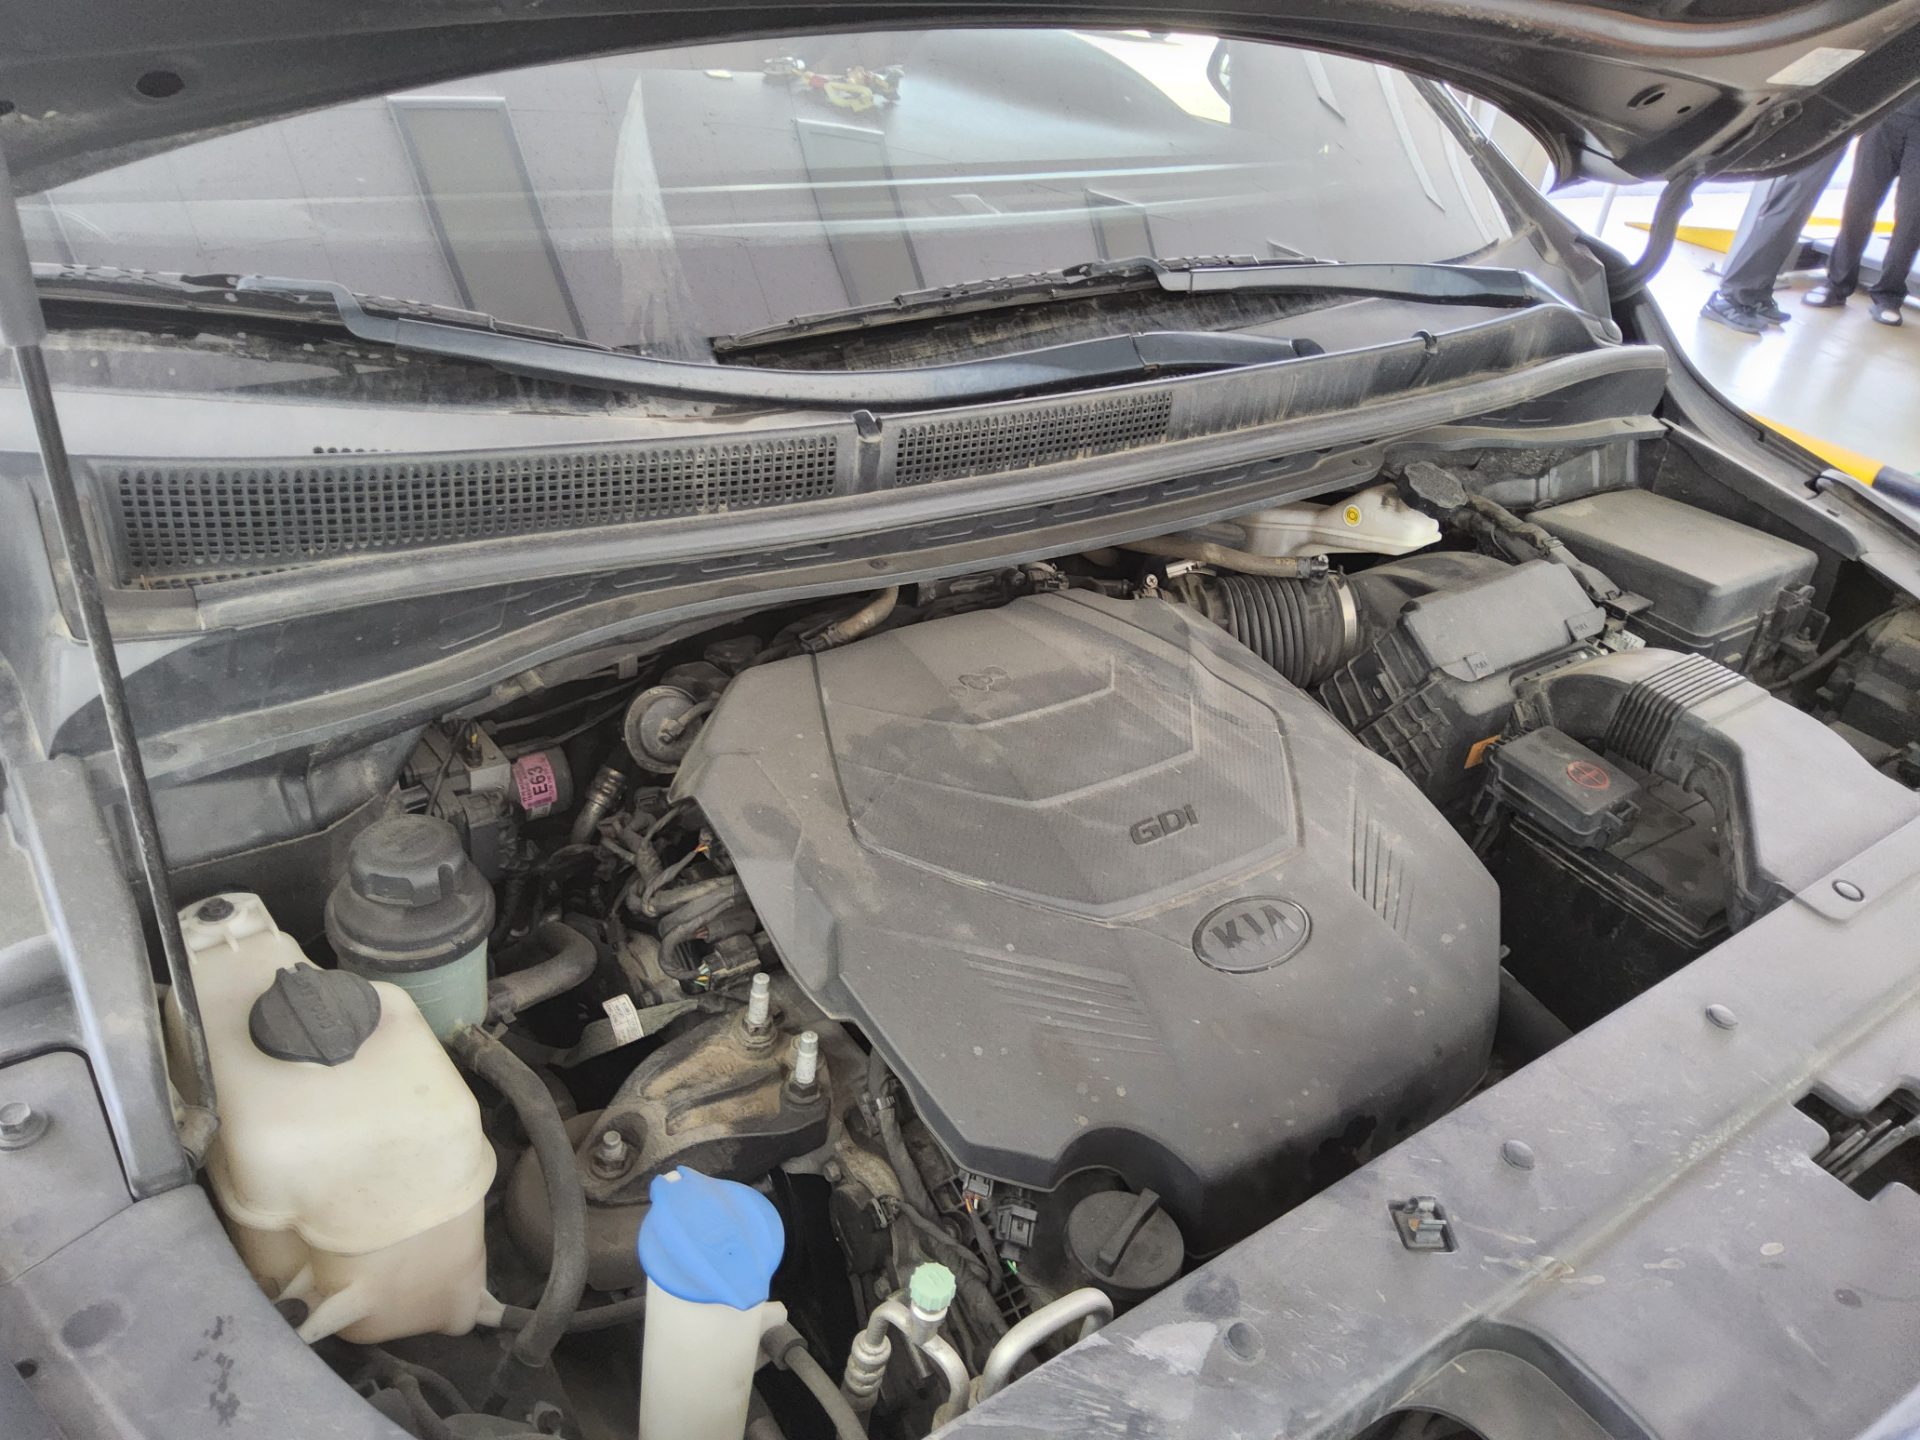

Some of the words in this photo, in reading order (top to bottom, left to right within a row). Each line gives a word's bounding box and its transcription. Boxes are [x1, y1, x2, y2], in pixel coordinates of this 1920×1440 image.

[528, 766, 548, 795] E63
[1130, 804, 1199, 846] GDI
[1211, 904, 1300, 955] KIA
